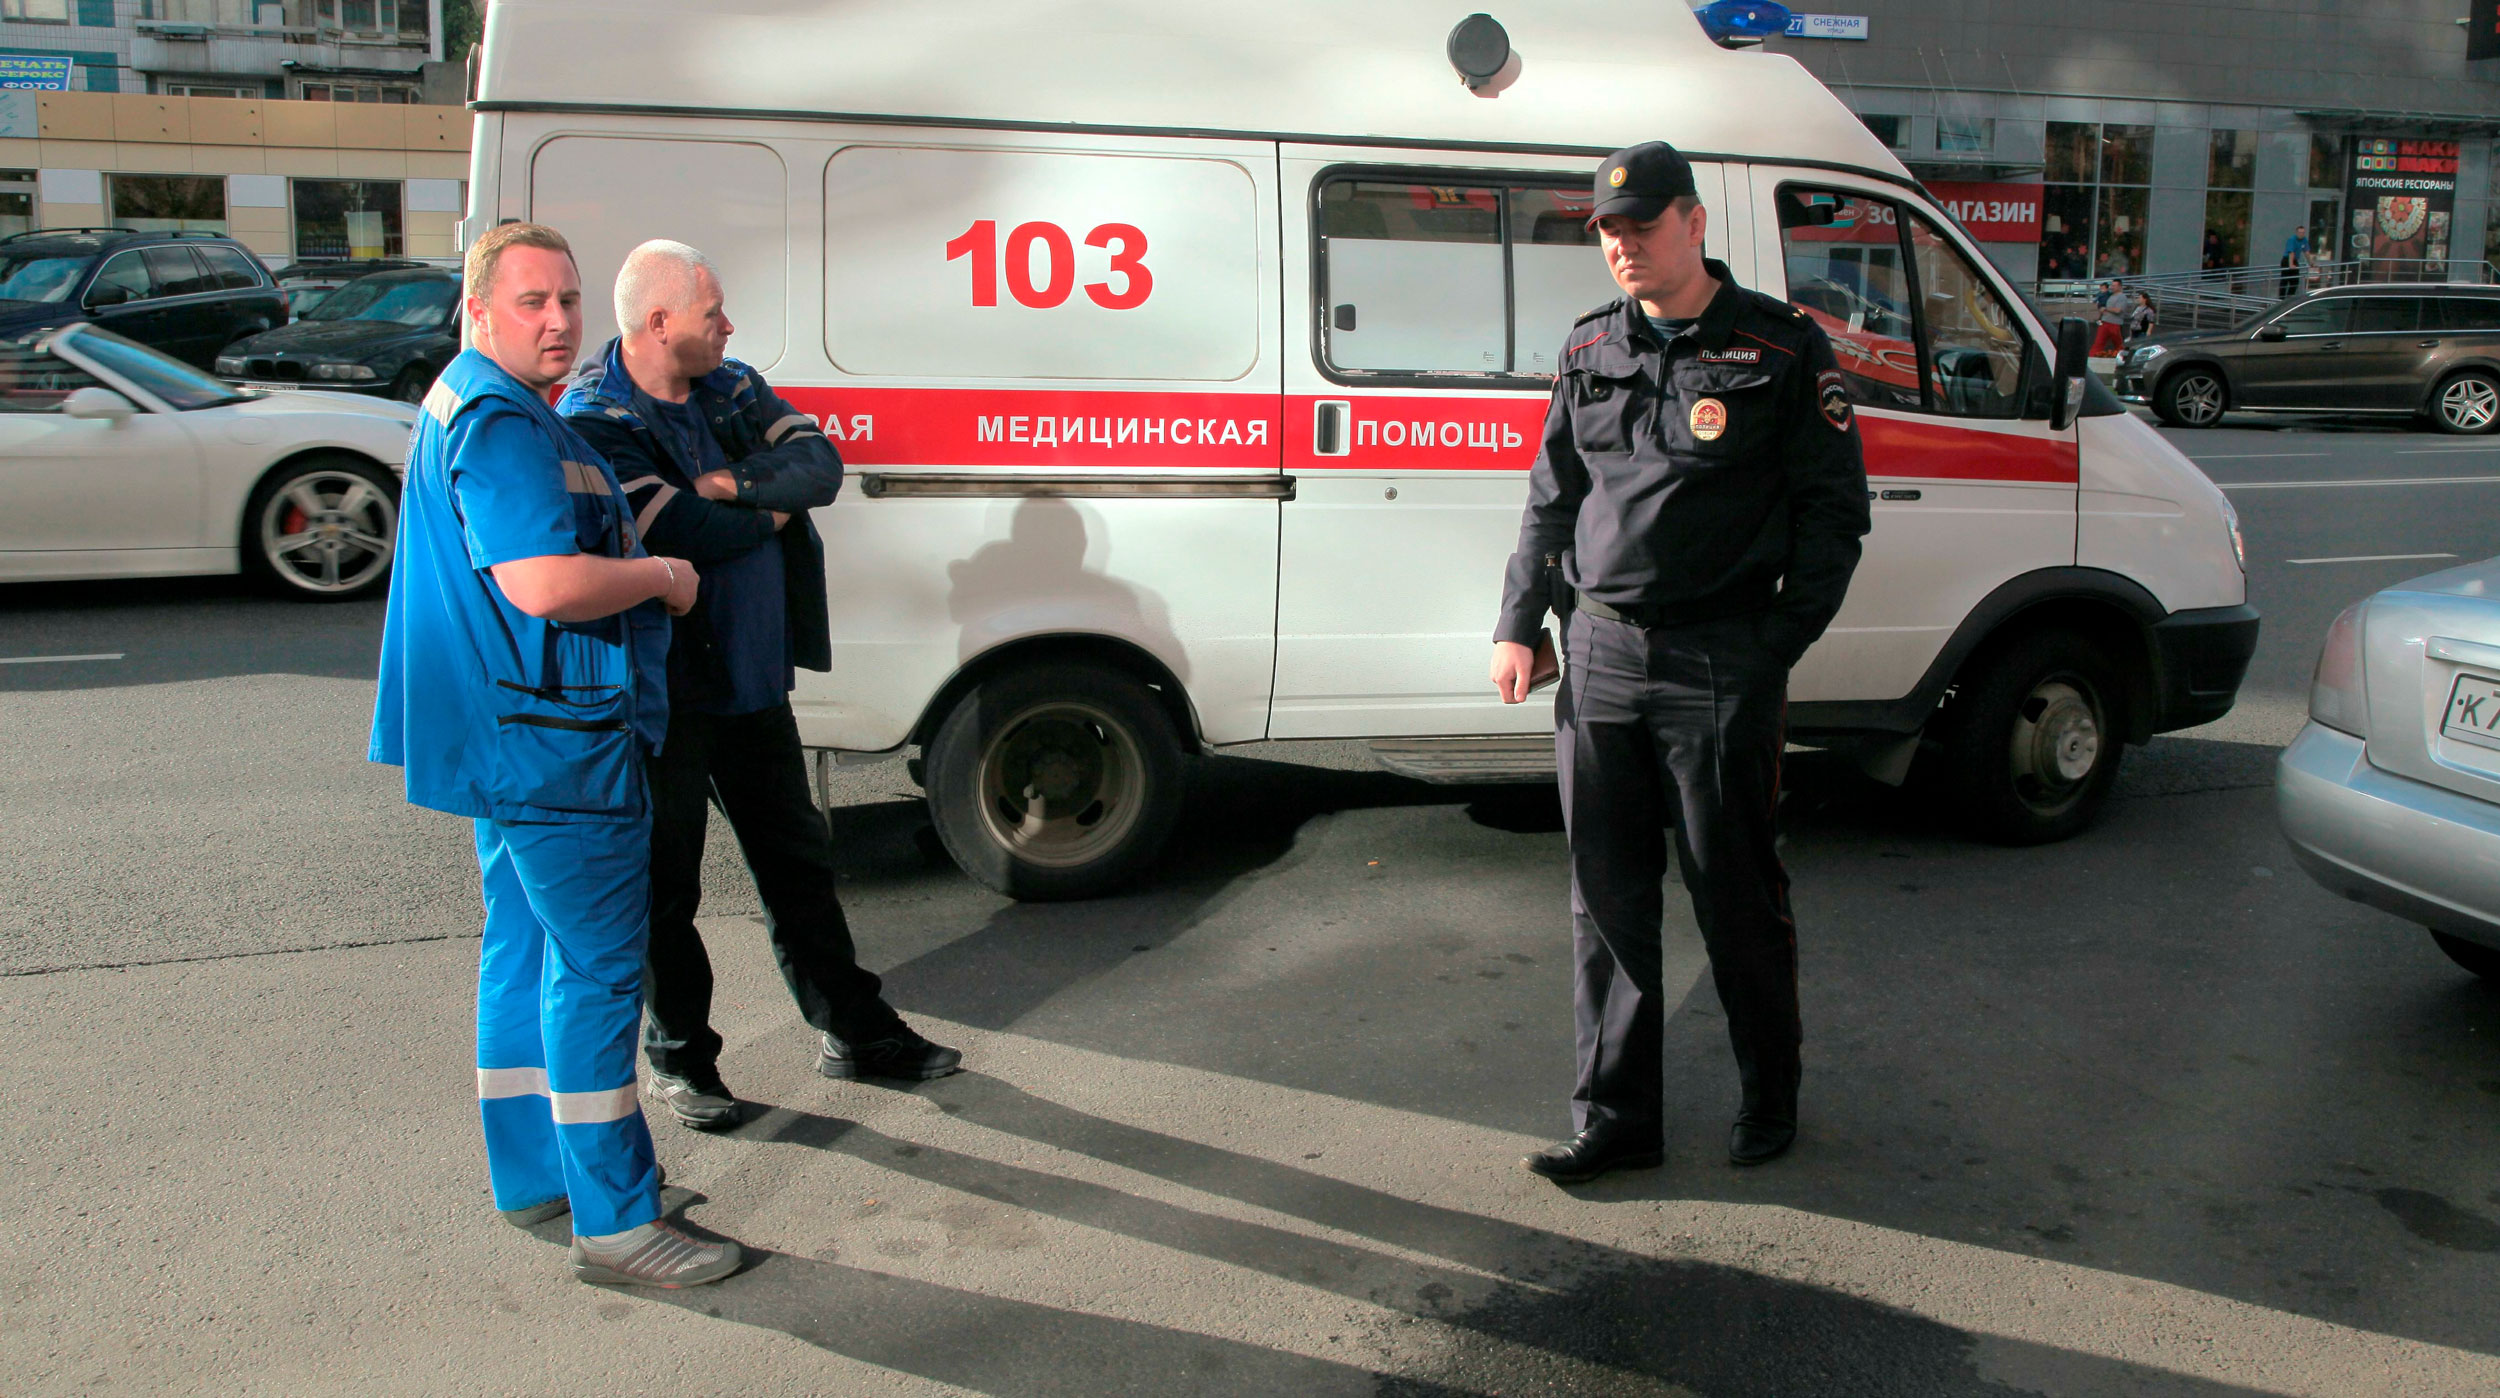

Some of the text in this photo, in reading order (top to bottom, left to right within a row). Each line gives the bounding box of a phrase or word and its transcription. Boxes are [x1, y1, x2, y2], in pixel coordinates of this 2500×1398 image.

[1788, 19, 1802, 31] 27
[1814, 18, 1859, 28] СНЕЖНАЯ
[3, 82, 60, 90] ФОТО
[2356, 178, 2455, 190] ЯПОНСКИЕ РЕСТОРАНЫ
[946, 219, 1154, 310] 103
[977, 415, 1268, 449] МЕДИЦИНСКАЯ
[1357, 420, 1523, 452] ПОМОЩЬ
